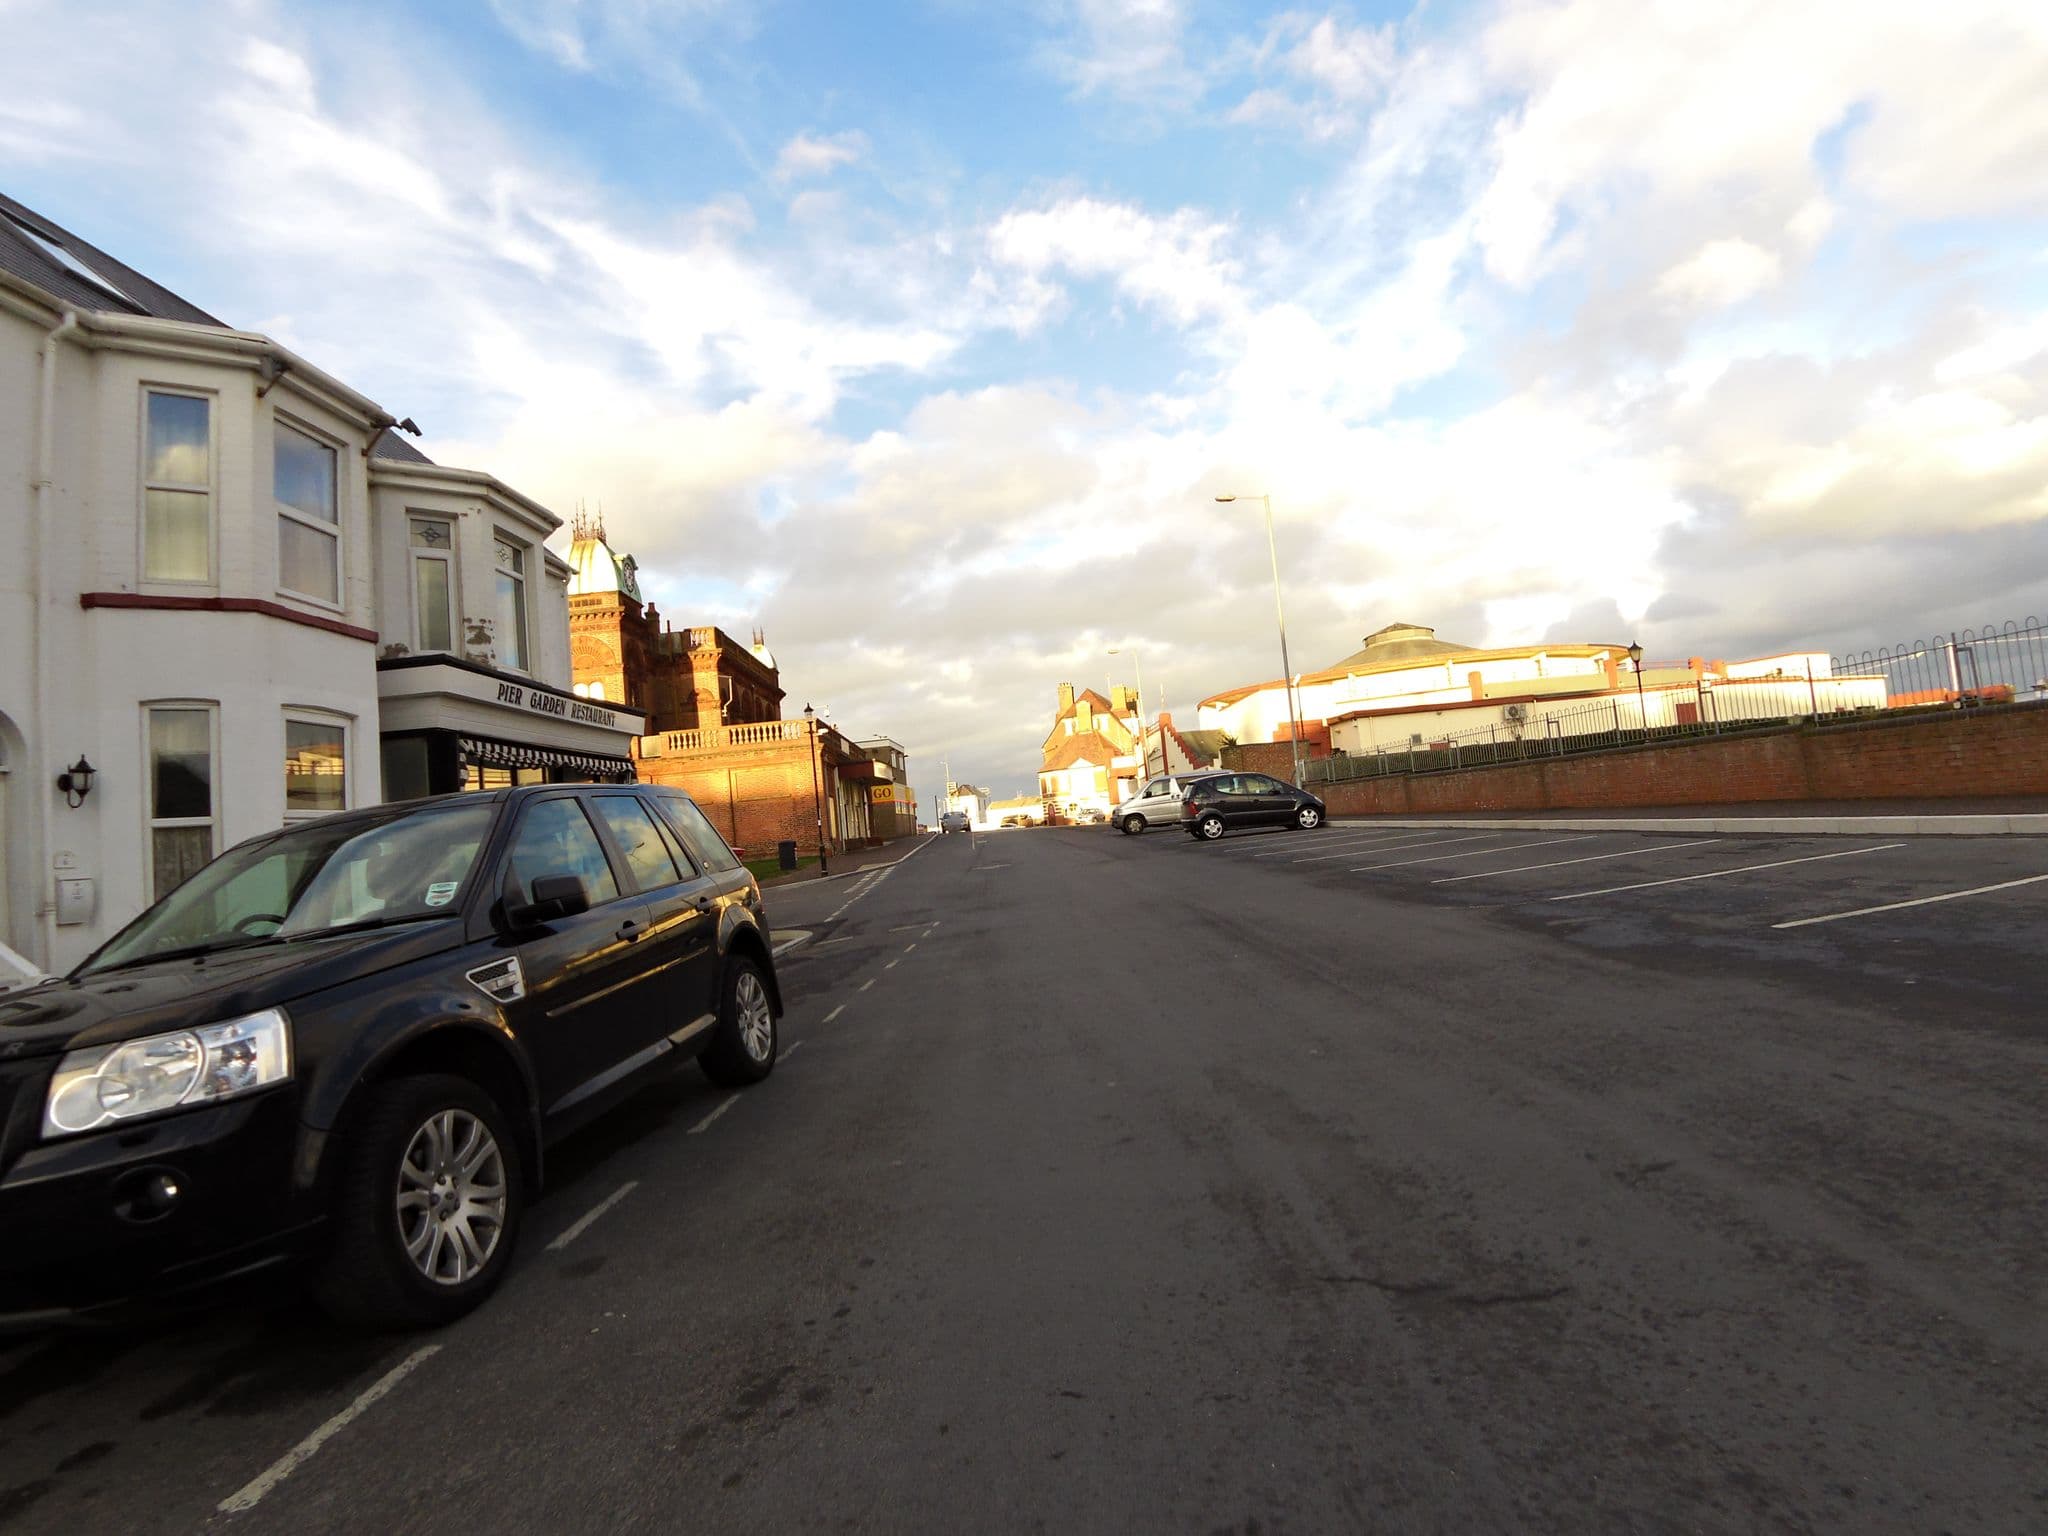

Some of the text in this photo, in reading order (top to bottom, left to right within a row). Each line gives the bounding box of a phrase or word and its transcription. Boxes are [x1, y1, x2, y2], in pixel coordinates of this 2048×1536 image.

[497, 683, 616, 727] PIER GARDEN RESTAURANT
[873, 787, 891, 799] GO
